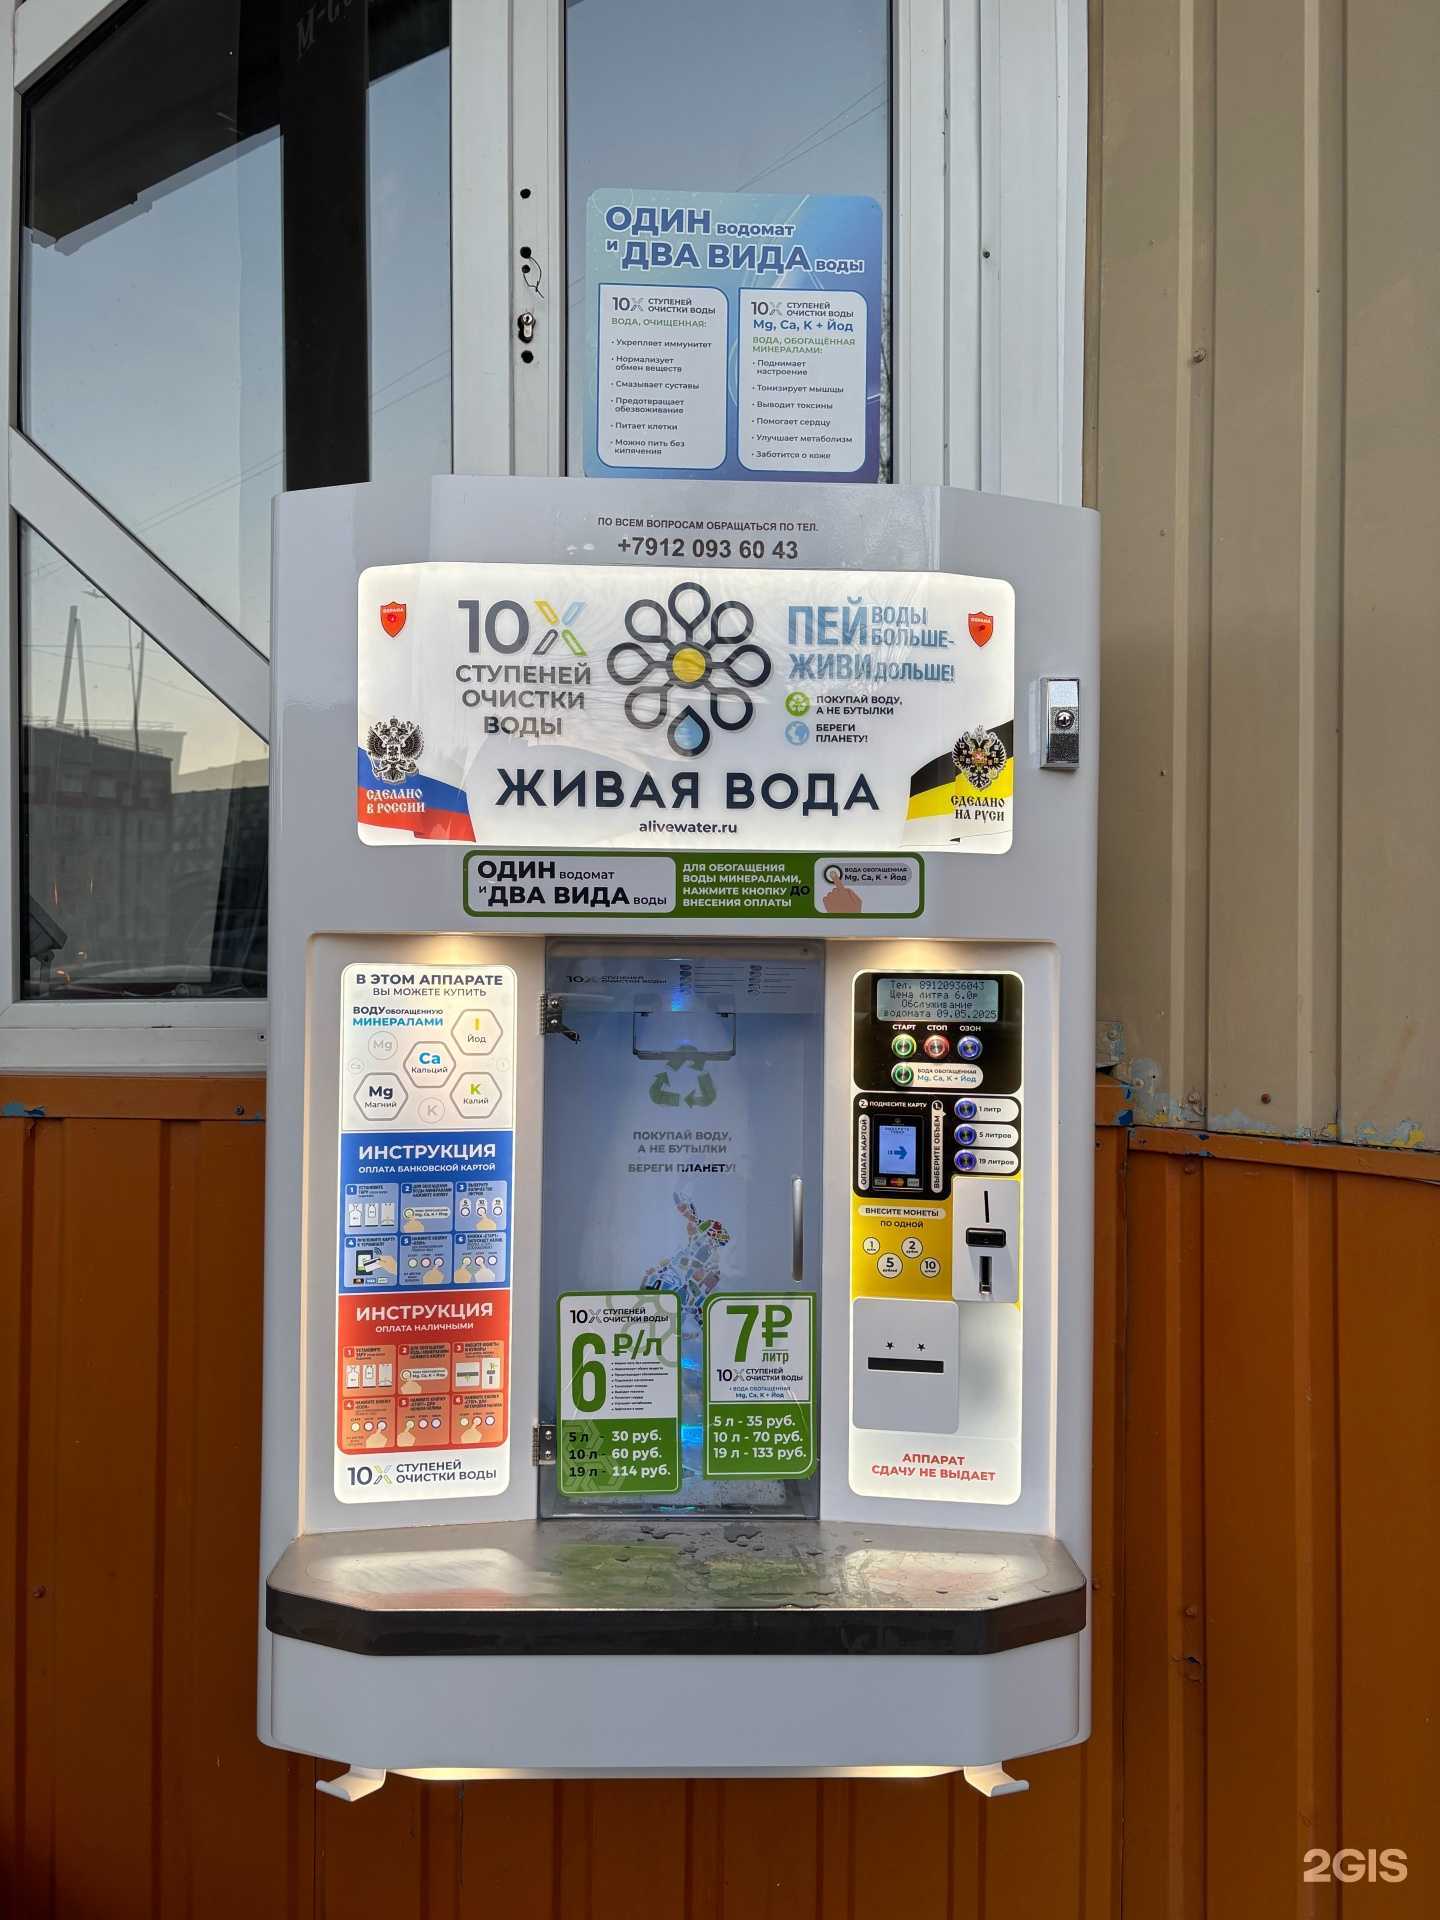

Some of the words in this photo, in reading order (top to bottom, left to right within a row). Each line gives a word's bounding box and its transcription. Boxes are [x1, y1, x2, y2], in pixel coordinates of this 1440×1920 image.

[605, 206, 711, 235] ОДИН
[717, 223, 794, 237] водомат
[622, 241, 700, 270] ДВА
[708, 245, 811, 273] ВИДА
[816, 260, 864, 272] воды
[648, 298, 692, 306] СТУПЕНЕЙ
[648, 305, 688, 313] ОЧИСТКИ
[611, 318, 641, 326] ВОДА,
[643, 319, 707, 328] ОЧИЩЕННАЯ:
[827, 319, 853, 332] Йод
[616, 338, 662, 348] Укрепляет
[664, 341, 712, 349] иммунитет
[752, 336, 782, 345] ВОДА,
[784, 337, 855, 346] ОБОГАЩЕННАЯ
[752, 346, 823, 354] МИНЕРАЛАМИ:
[616, 355, 674, 365] Нормализует
[757, 360, 806, 368] Поднимает
[615, 364, 643, 372] обмен
[756, 369, 807, 377] настроение
[664, 383, 700, 391] суставы
[757, 385, 807, 394] Тонизирует
[615, 397, 685, 406] Предотвращает
[757, 401, 794, 409] Выводит
[615, 422, 645, 430] Питает
[615, 439, 646, 447] Можно
[756, 434, 798, 443] Улучшает
[598, 517, 613, 526] ПО
[616, 518, 644, 528] ВСЕМ
[646, 519, 704, 530] ВОПРОСАМ
[707, 521, 776, 532] ОБРАЩАТЬСЯ
[780, 523, 794, 531] ПО
[797, 523, 819, 532] ТЕЛ.
[618, 537, 684, 557] +7912
[692, 539, 731, 558] 093
[739, 540, 765, 559] 60
[772, 541, 798, 559] 43
[788, 596, 868, 646] ПЕЙ
[872, 606, 927, 626] ВОДЫ
[788, 653, 871, 680] ЖИВИ
[874, 662, 954, 682] ДОЛЬШЕ!
[456, 662, 590, 685] СТУПЕНЕЙ
[462, 689, 584, 709] ОЧИСТКИ
[816, 693, 868, 705] ПОКУПАЙ
[871, 695, 903, 707] ВОДУ,
[827, 706, 840, 715] НЕ
[843, 706, 894, 716] БУТЫЛКИ
[484, 716, 562, 737] ВОДЫ
[816, 723, 856, 733] БЕРЕГИ
[816, 733, 869, 744] ПЛАНЕТУ!
[366, 788, 422, 801] СДЕЛАНО
[495, 768, 699, 809] ЖИВАЯ
[726, 772, 879, 816] ВОДА
[377, 802, 425, 813] РОССИИ
[639, 820, 737, 834] alivewater.ru
[478, 860, 555, 881] ОДИН
[559, 871, 614, 880] водомат
[683, 864, 707, 873] ДЛЯ
[709, 864, 785, 874] ОБОГАЩЕНИЯ
[683, 875, 717, 884] ВОДЫ
[719, 875, 802, 884] МИНЕРАЛАМИ,
[683, 887, 739, 896] НАЖМИТЕ
[742, 887, 787, 896] КНОПКУ
[790, 885, 810, 897] ДО
[488, 886, 546, 907] ДВА
[554, 887, 630, 908] ВИДА
[633, 897, 667, 906] воды
[683, 899, 741, 907] ВНЕСЕНИЯ
[743, 899, 792, 908] ОПЛАТЫ
[357, 974, 366, 984] В
[371, 974, 414, 985] ЭТОМ
[419, 975, 503, 986] АППАРАТЕ
[890, 980, 912, 989] Тел.
[920, 980, 985, 990] 89120936043
[373, 988, 391, 996] ВЫ
[393, 988, 440, 996] МОЖЕТЕ
[444, 988, 486, 997] КУПИТЬ
[890, 991, 914, 1000] Цена
[919, 992, 949, 1000] литра
[901, 1000, 973, 1009] Обслуживание
[353, 1007, 386, 1015] ВОДУ
[936, 1009, 997, 1019] 09.05.2025
[352, 1018, 443, 1026] МИНЕРАЛАМИ
[369, 1086, 393, 1100] Mg
[365, 1101, 397, 1109] Магний
[464, 1097, 489, 1105] Калий
[633, 1130, 692, 1141] ПОКУПАЙ
[696, 1131, 732, 1142] ВОДУ,
[359, 1144, 496, 1160] ИНСТРУКЦИЯ
[650, 1144, 665, 1153] НЕ
[668, 1144, 727, 1153] БУТЫЛКИ
[359, 1166, 395, 1174] ОПЛАТА
[398, 1164, 459, 1173] БАНКОВСКОЙ
[461, 1163, 496, 1171] КАРТОЙ
[628, 1164, 673, 1173] БЕРЕГИ
[677, 1164, 736, 1173] ПЛАНЕТУ!
[903, 1209, 939, 1217] МОНЕТЫ
[894, 1220, 924, 1228] ОДНОЙ
[356, 1303, 493, 1321] ИНСТРУКЦИЯ
[603, 1315, 642, 1323] ОЧИСТКИ
[643, 1315, 669, 1323] ВОДЫ
[376, 1325, 412, 1333] ОПЛАТА
[414, 1322, 474, 1331] НАЛИЧНЫМИ
[726, 1305, 759, 1363] 7
[762, 1352, 789, 1364] литр
[571, 1332, 607, 1413] 6
[713, 1416, 722, 1427] 5
[746, 1416, 763, 1427] 35
[767, 1414, 795, 1429] руб.
[612, 1430, 629, 1441] 30
[632, 1428, 662, 1444] руб.
[713, 1432, 728, 1442] 10
[753, 1431, 770, 1442] 70
[774, 1430, 803, 1446] руб.
[569, 1449, 585, 1460] 10
[612, 1447, 629, 1459] 60
[632, 1445, 662, 1461] руб.
[713, 1447, 727, 1458] 19
[752, 1447, 773, 1458] 133
[777, 1446, 807, 1461] руб.
[902, 1453, 965, 1466] АППАРАТ
[396, 1459, 462, 1473] СТУПЕНЕЙ
[569, 1467, 585, 1477] 19
[612, 1465, 637, 1476] 114
[641, 1463, 671, 1479] руб.
[396, 1474, 457, 1484] ОЧИСТКИ
[459, 1470, 497, 1481] ВОДЫ
[871, 1465, 916, 1477] СДАЧУ
[920, 1469, 936, 1477] НЕ
[940, 1469, 996, 1481] ВЫДАЕТ
